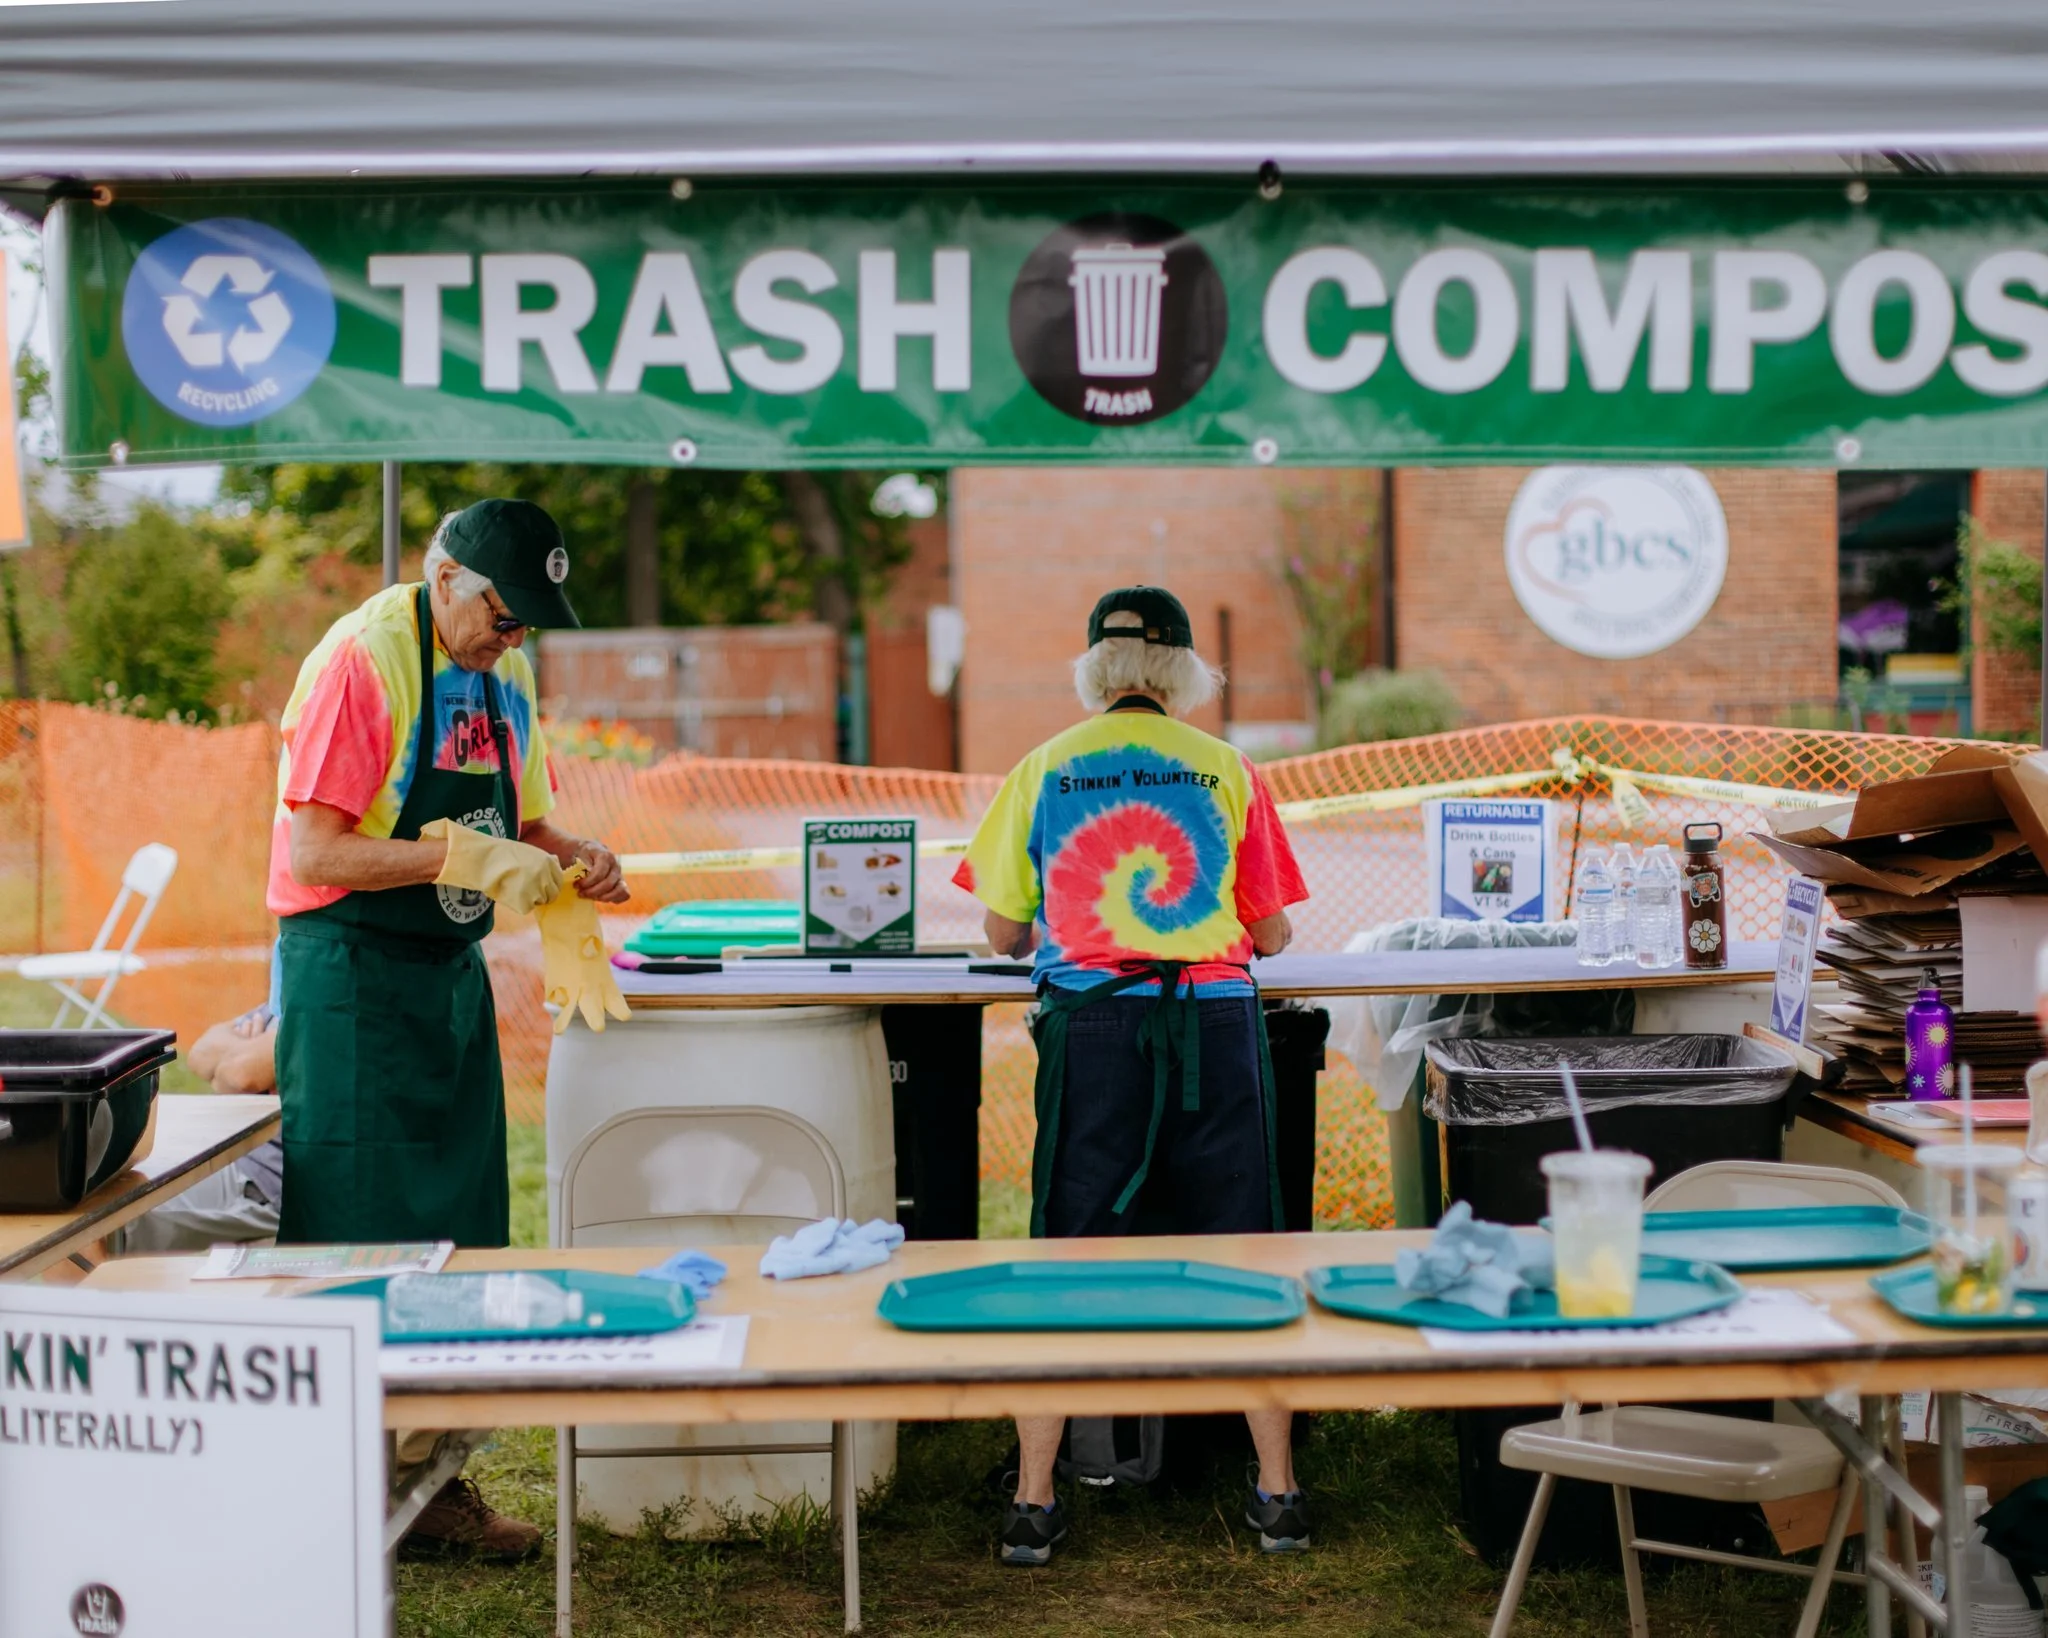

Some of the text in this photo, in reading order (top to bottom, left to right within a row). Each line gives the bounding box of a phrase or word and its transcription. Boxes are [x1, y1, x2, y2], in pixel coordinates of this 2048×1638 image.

[368, 246, 2048, 396] TRASH COMPOS
[177, 379, 279, 412] RECYCLING
[1084, 387, 1153, 415] TRASH
[1558, 519, 1691, 583] gbcs
[1446, 804, 1539, 818] RETURNABLE
[827, 823, 912, 839] COMPOST
[1451, 829, 1536, 842] Drink Bottles
[1469, 847, 1516, 859] & Cans
[441, 896, 493, 920] ZERO WAST
[1474, 896, 1490, 907] VT
[408, 1352, 655, 1364] ON TRAYS
[126, 1337, 321, 1407] TRASH
[1985, 1413, 2032, 1436] FIRST
